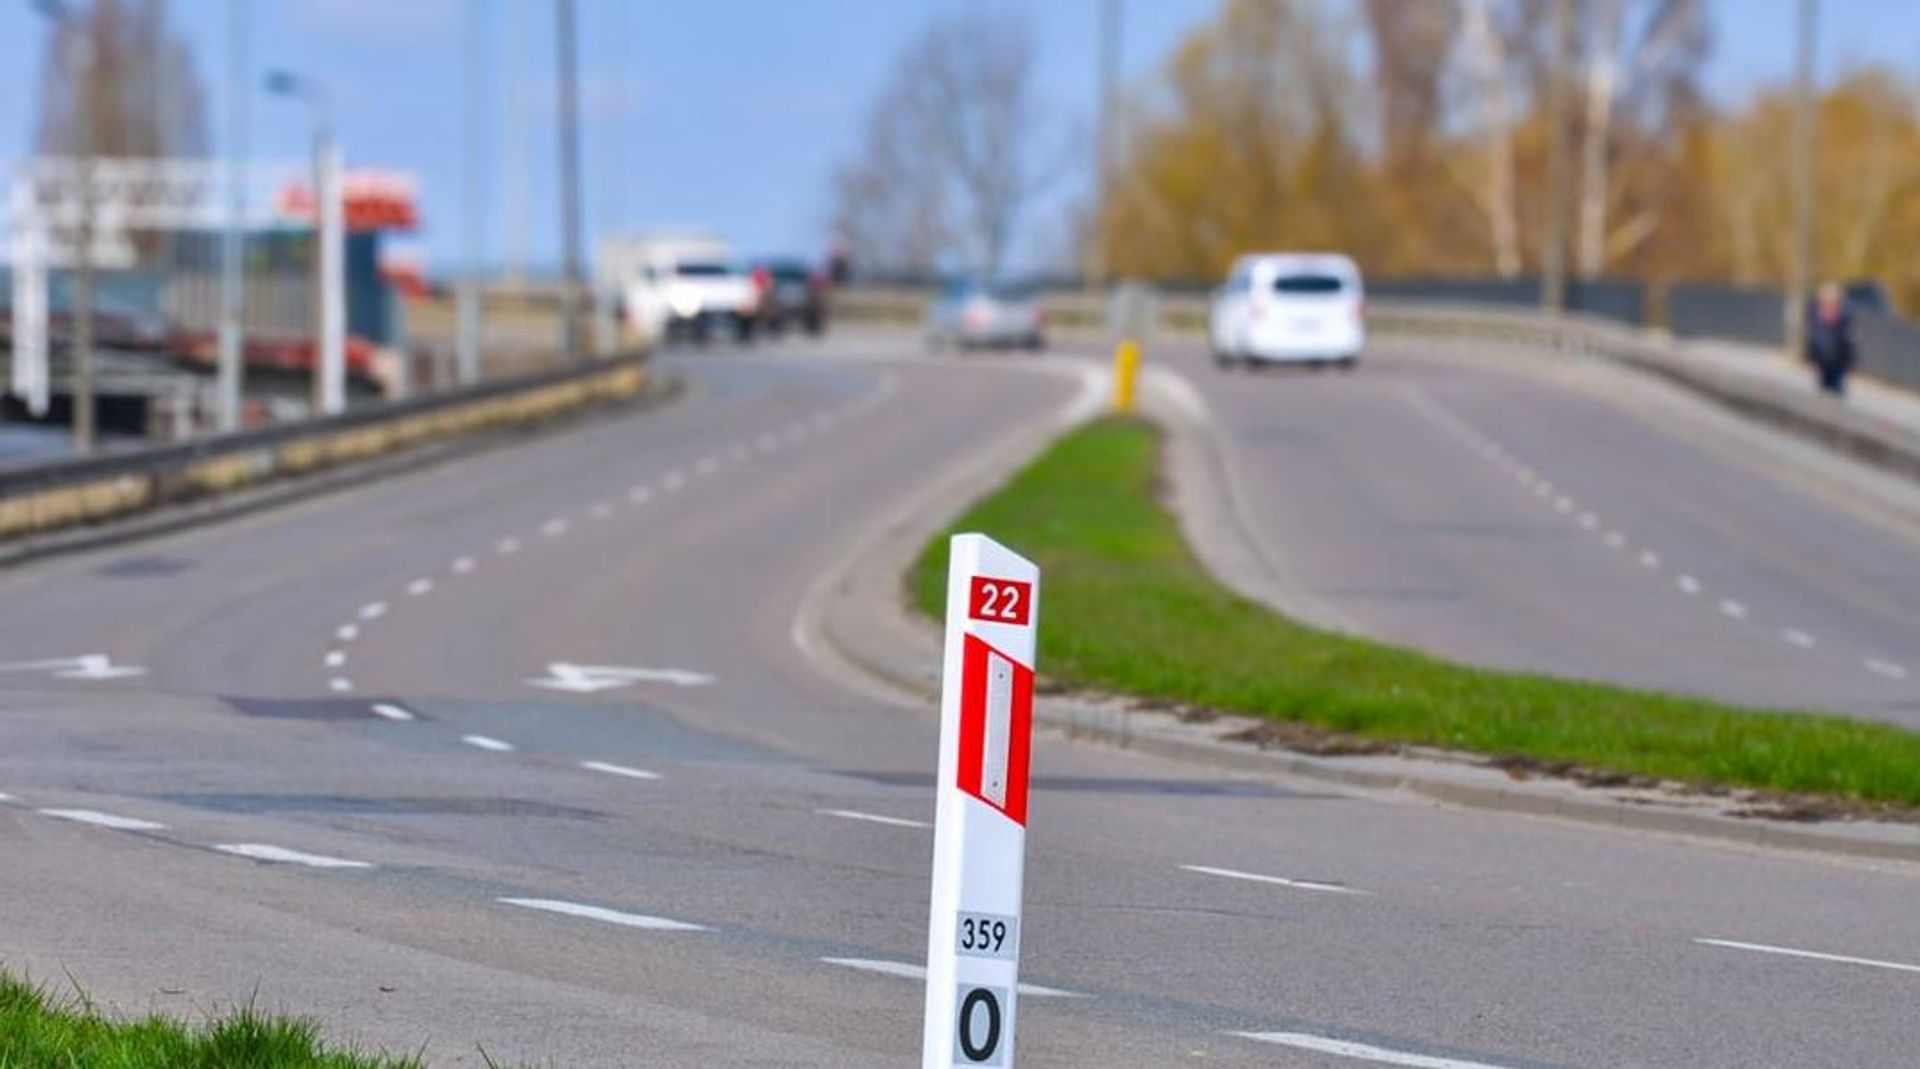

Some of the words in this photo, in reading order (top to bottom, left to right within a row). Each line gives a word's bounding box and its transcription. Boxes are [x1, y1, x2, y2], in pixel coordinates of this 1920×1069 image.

[981, 583, 1019, 618] 22
[962, 918, 1006, 952] 359
[959, 987, 1000, 1062] 0
